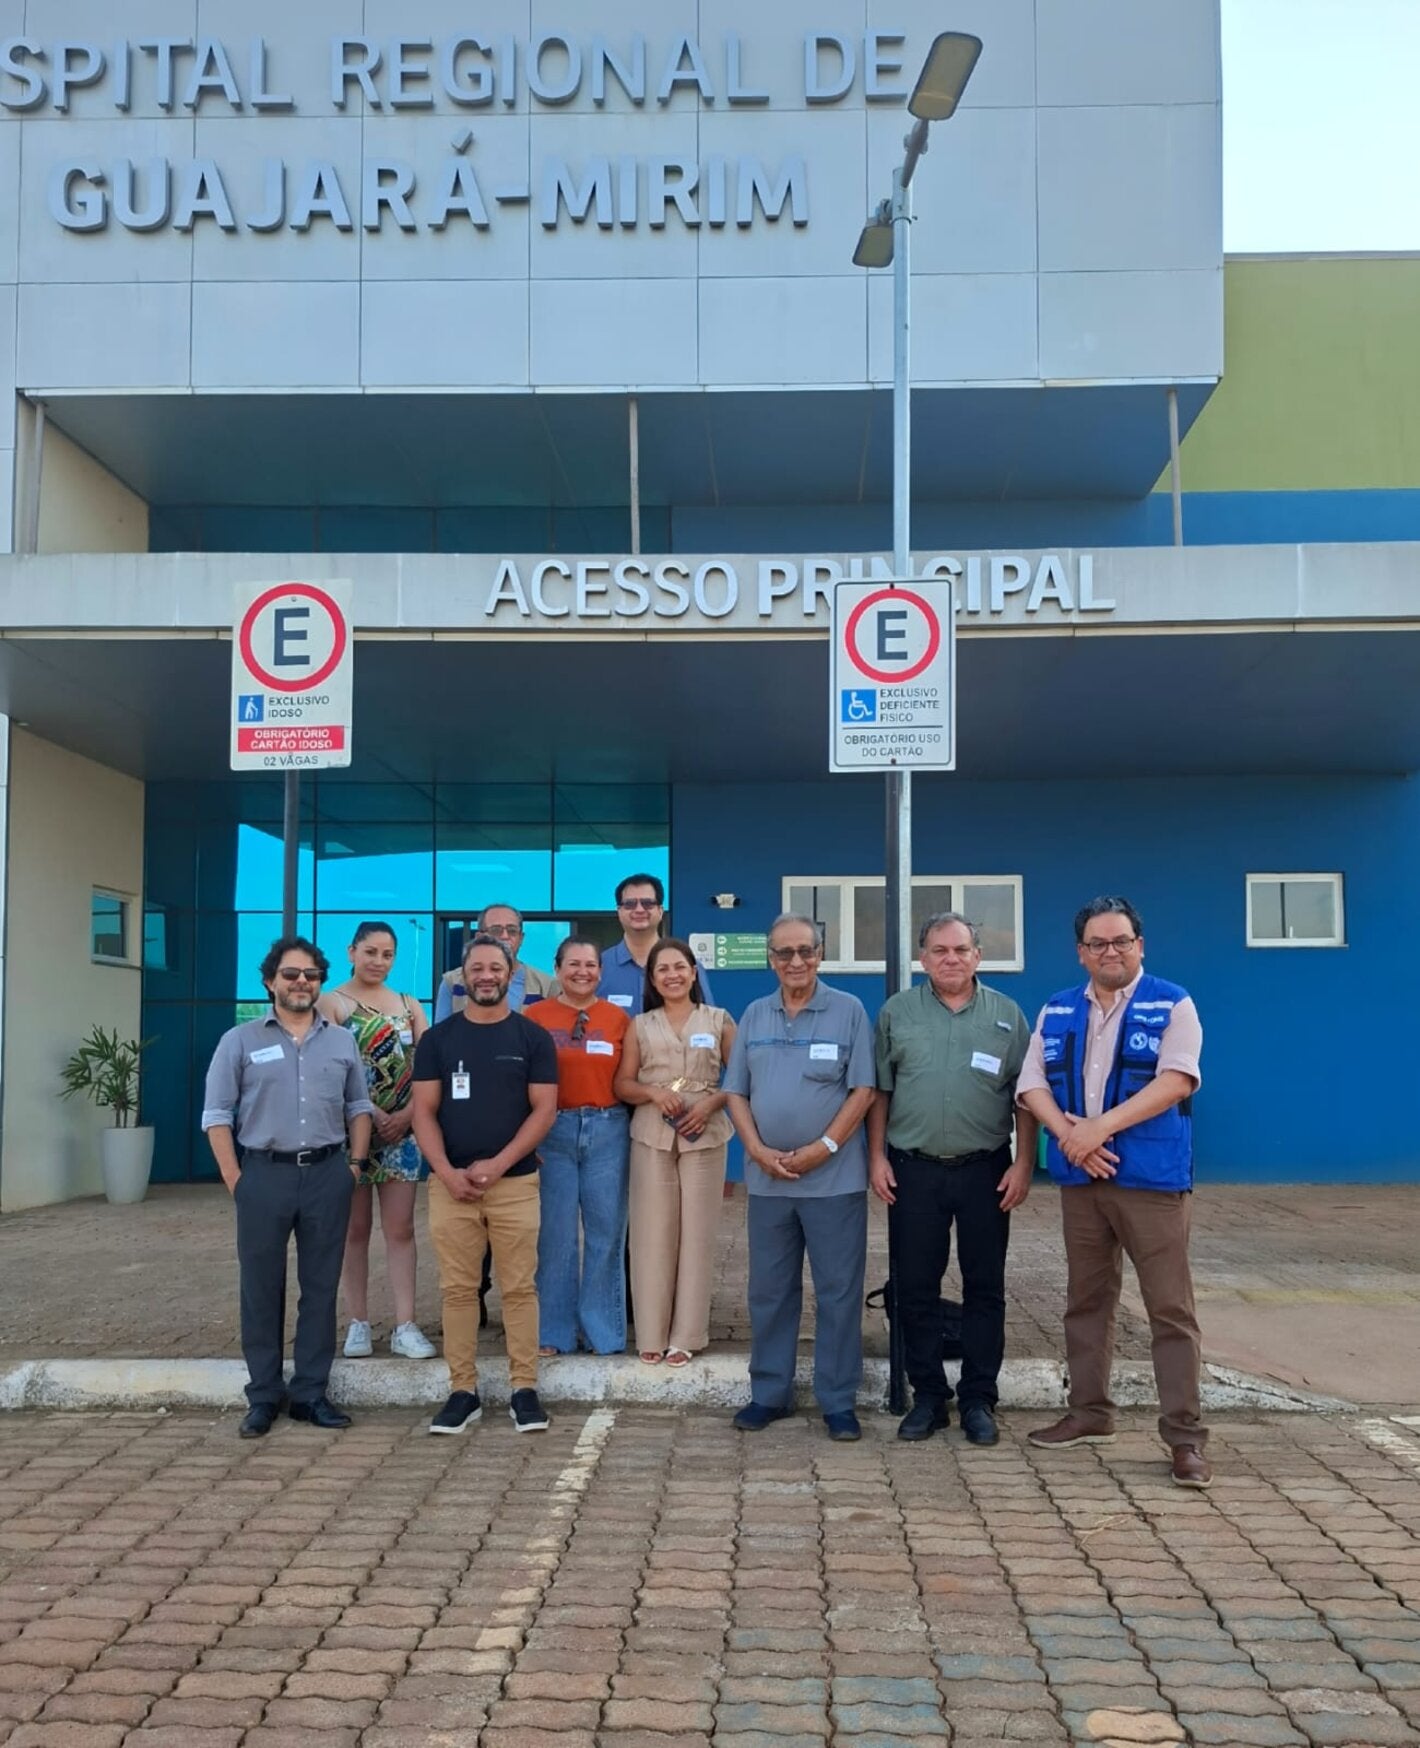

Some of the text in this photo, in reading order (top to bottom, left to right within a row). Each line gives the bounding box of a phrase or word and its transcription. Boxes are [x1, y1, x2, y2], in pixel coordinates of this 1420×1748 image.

[329, 31, 770, 109] REGIONAL
[803, 29, 908, 104] DE
[49, 129, 809, 232] GUAJARÁ-MIRIM
[485, 559, 738, 617] ACESSO
[274, 607, 310, 665] E
[877, 610, 908, 660] E
[880, 687, 938, 698] EXCLUSIVO
[268, 694, 330, 706] EXCLUSIVO
[880, 700, 940, 710] DEFICIENTE
[268, 708, 303, 718] IDOSO
[299, 739, 333, 749] IDOSO
[918, 733, 942, 744] USO
[862, 747, 877, 757] DO
[263, 756, 277, 767] 02
[279, 755, 319, 767] VAGAS
